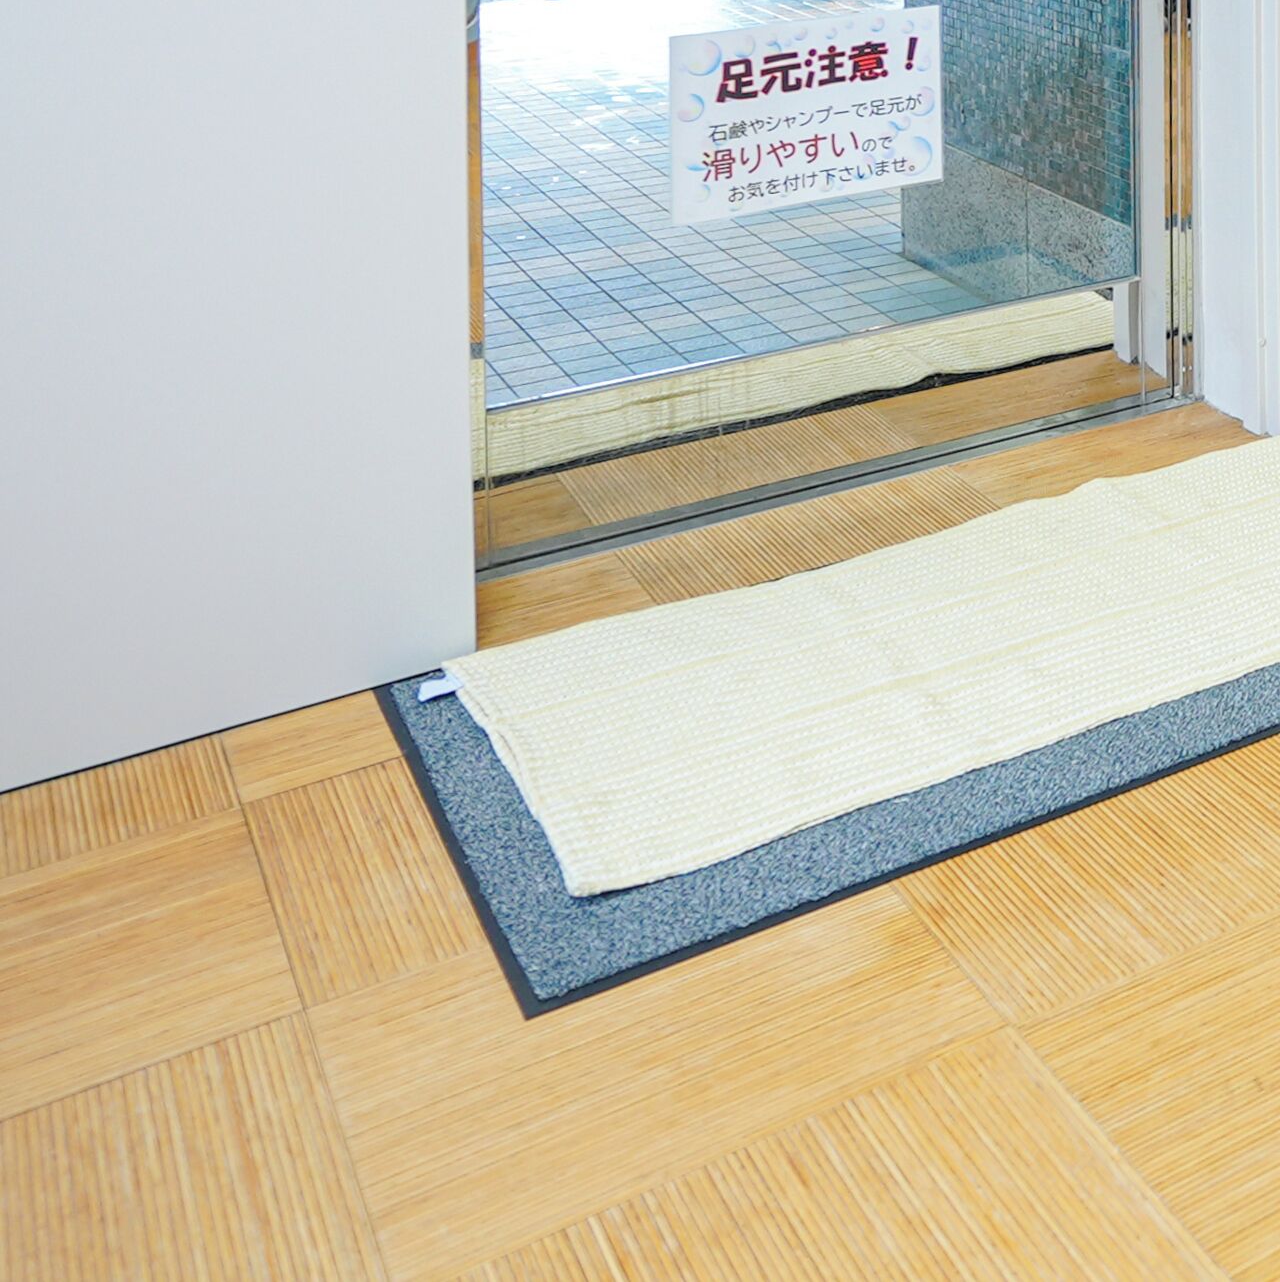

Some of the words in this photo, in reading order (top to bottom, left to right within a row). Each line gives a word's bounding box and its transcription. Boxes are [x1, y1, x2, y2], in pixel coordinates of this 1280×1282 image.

[715, 37, 919, 103] 足元注意！
[708, 93, 923, 144] 石鹸やシャンプーで足元が
[702, 130, 893, 183] 滑りやすいので
[728, 157, 917, 204] お気を付け下さいませ。
